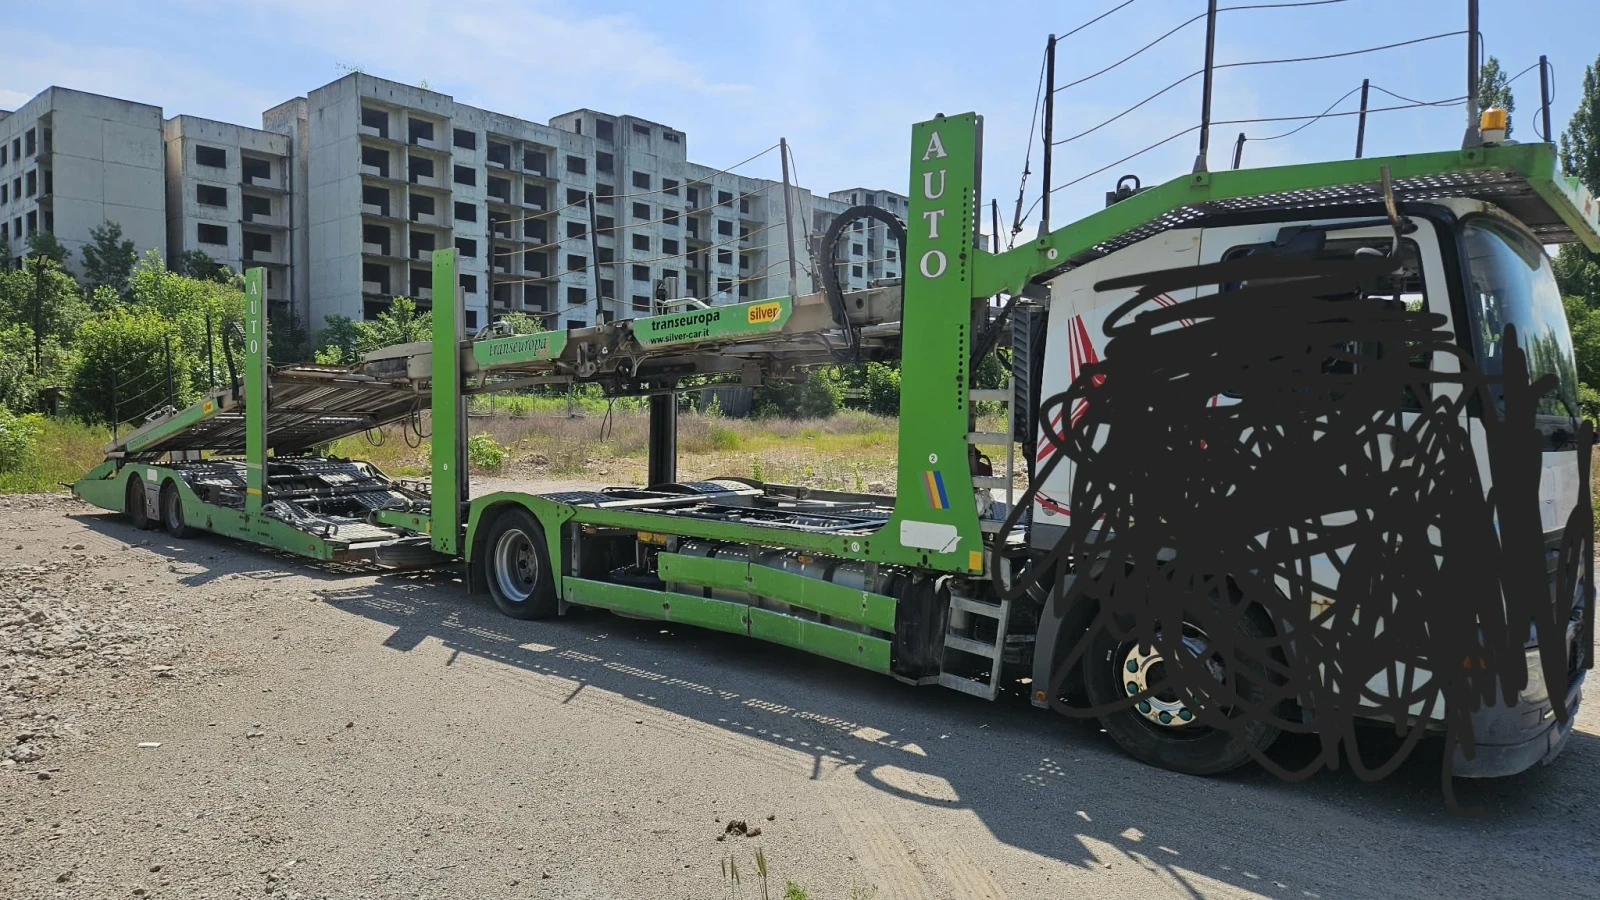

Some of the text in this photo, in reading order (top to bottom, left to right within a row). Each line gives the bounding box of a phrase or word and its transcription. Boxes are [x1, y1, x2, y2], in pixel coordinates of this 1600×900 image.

[919, 131, 948, 278] AUTO
[250, 281, 258, 354] AUTO
[651, 311, 720, 331] transeuropa
[750, 306, 778, 321] silver
[489, 338, 547, 356] transeuropa
